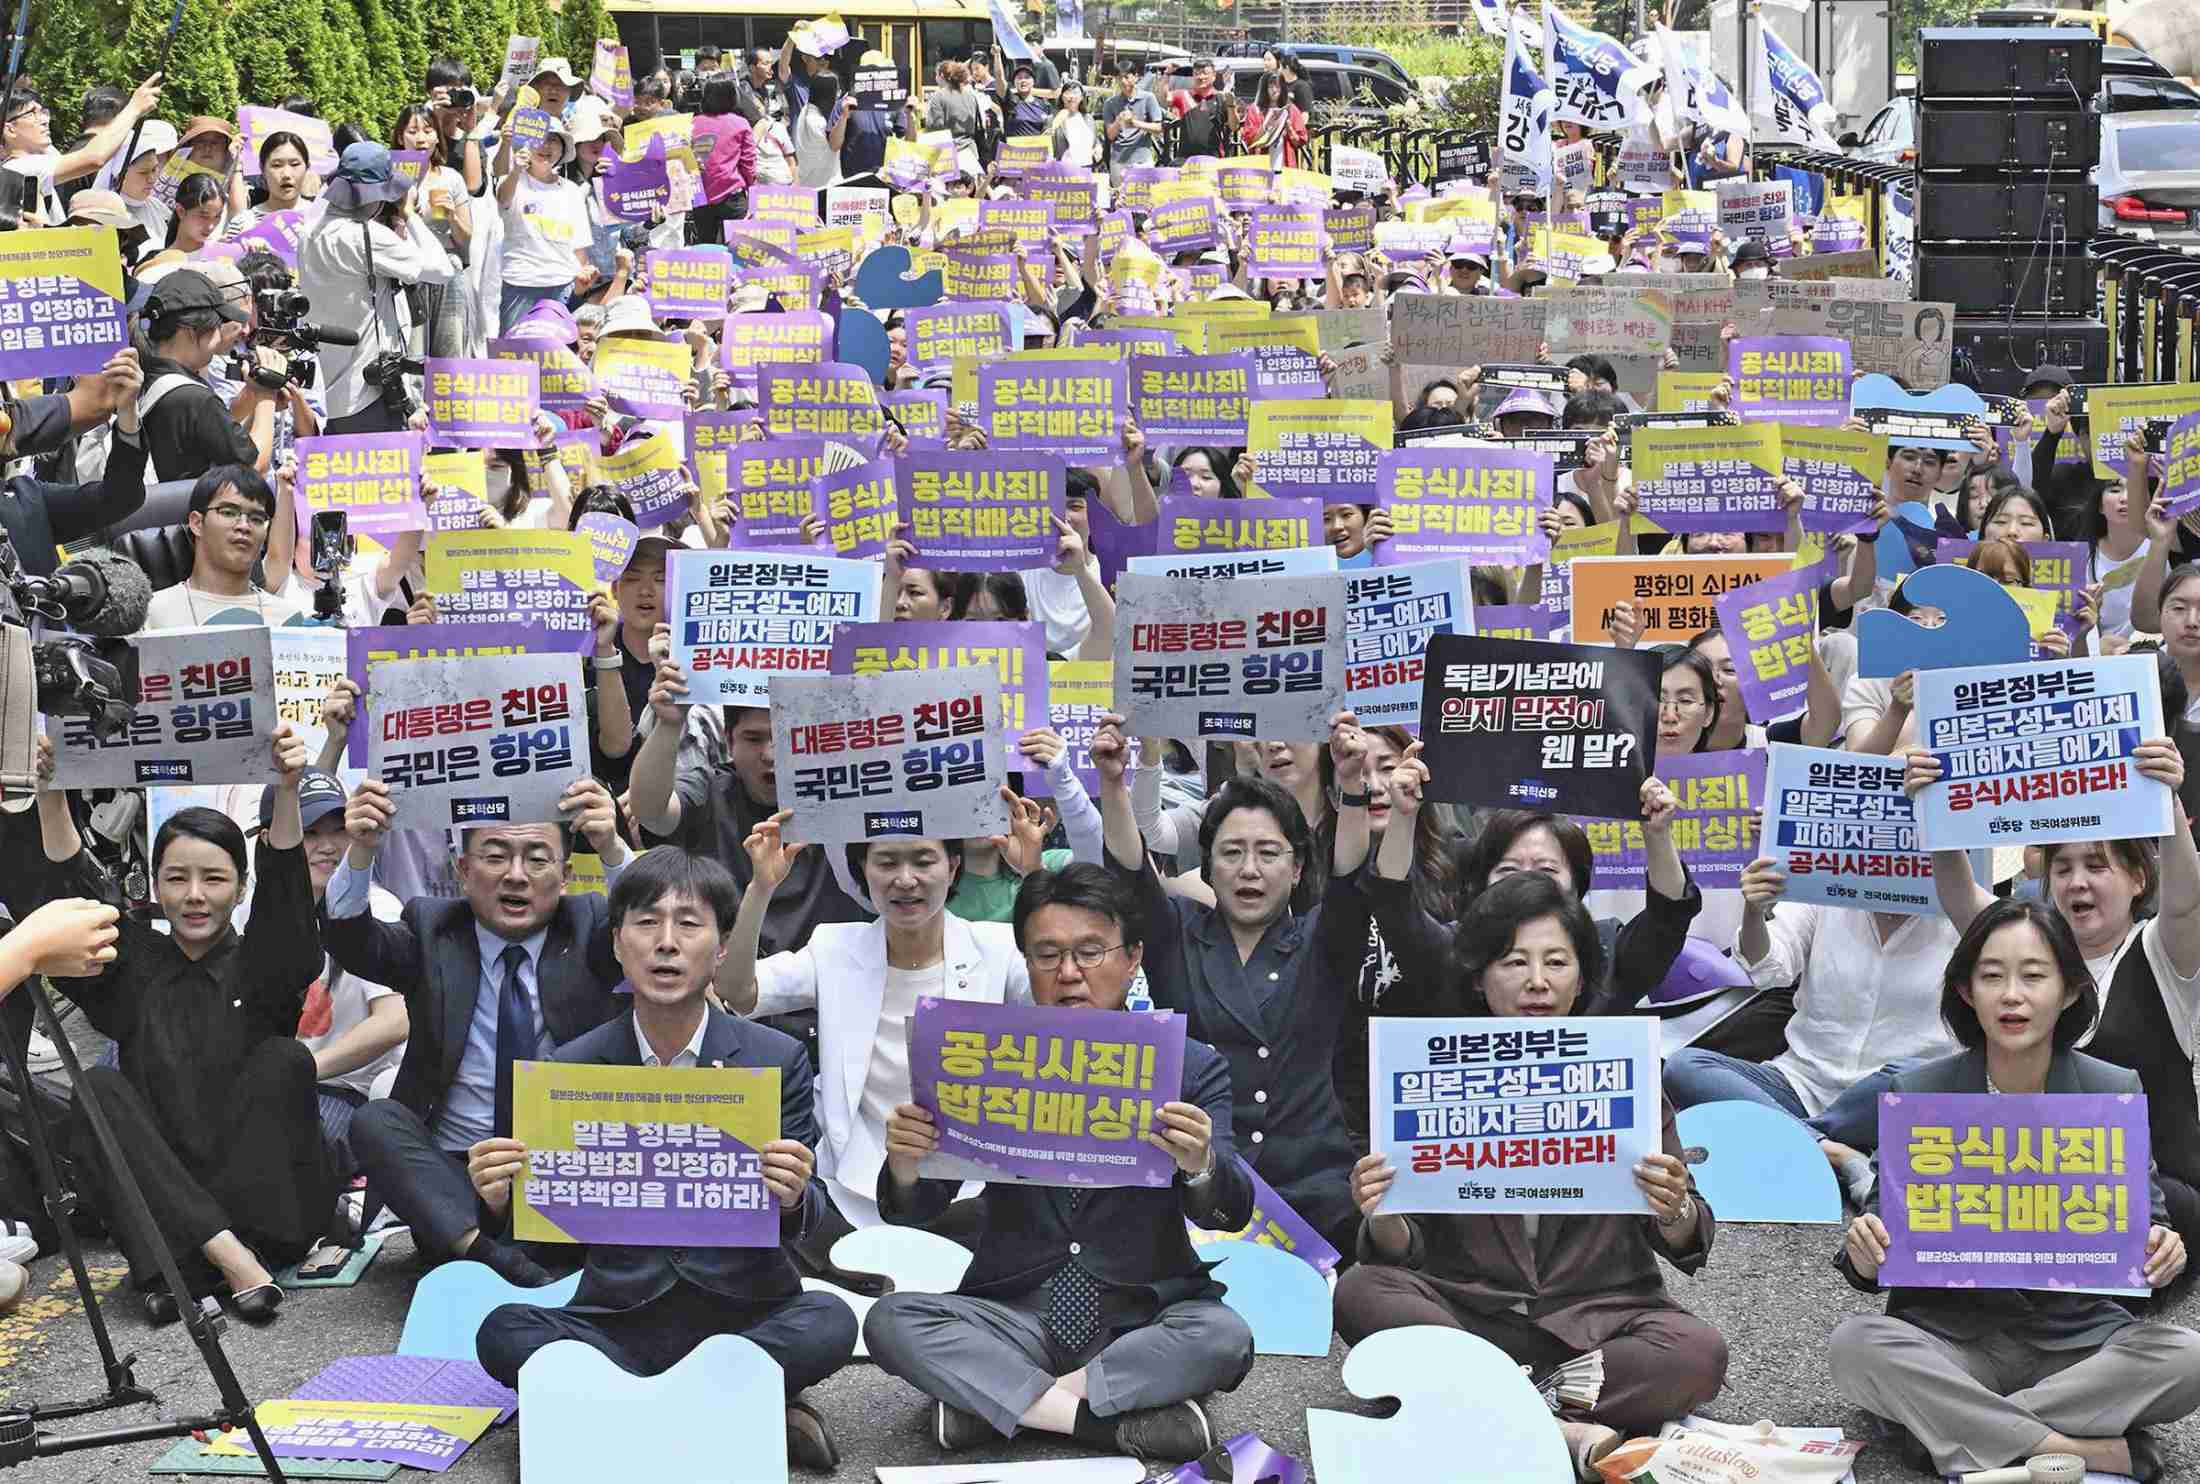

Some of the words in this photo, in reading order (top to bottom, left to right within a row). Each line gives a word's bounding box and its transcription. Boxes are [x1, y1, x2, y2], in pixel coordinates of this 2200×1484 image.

[17, 273, 80, 299] 정부는
[31, 297, 116, 323] 인정하고
[51, 320, 122, 347] 다하라!
[992, 377, 1113, 406] 공식사죄!
[1141, 368, 1247, 395] 공식사죄!
[991, 409, 1114, 439] 법적배상!
[1315, 430, 1362, 450] 정부는
[1393, 467, 1536, 501] 공식사죄!
[1663, 459, 1697, 478] 일본
[1702, 458, 1752, 477] 정부는
[1805, 459, 1852, 477] 정부는
[911, 470, 1049, 501] 공식사죄!
[1636, 477, 1706, 496] 전쟁범죄
[1711, 475, 1778, 493] 인정하고
[1811, 478, 1874, 495] 인정하고
[911, 507, 1054, 539] 법적배상!
[1173, 516, 1311, 551] 공식사죄!
[1391, 503, 1537, 539] 법적배상!
[460, 569, 499, 590] 일본
[503, 568, 560, 589] 정부는
[708, 562, 831, 589] 일본정부는
[1633, 573, 1695, 599] 평화의
[514, 590, 591, 610] 인정하고
[689, 591, 860, 620] 일본군성노예제
[1132, 620, 1248, 655] 대통령은
[1255, 606, 1327, 650] 친일
[179, 656, 255, 703] 친일
[719, 682, 749, 696] 민주당
[1131, 662, 1231, 700] 국민은
[1241, 649, 1324, 695] 항일
[1443, 660, 1605, 693] 독립기념관에
[1954, 667, 2096, 712] 일본정부는
[171, 696, 255, 746] 항일
[383, 697, 492, 744] 대통령은
[500, 682, 570, 728] 친일
[790, 711, 906, 757] 대통령은
[912, 694, 985, 743] 친일
[1441, 696, 1506, 733] 일제
[1511, 695, 1605, 732] 밀정이
[1933, 695, 2134, 748] 일본군성노예제
[382, 745, 480, 790] 국민은
[488, 725, 572, 778] 항일
[1541, 733, 1577, 771] 웬
[1583, 732, 1638, 770] 말?
[1950, 730, 2121, 780] 피해자들에게
[794, 759, 894, 802] 국민은
[902, 738, 986, 796] 항일
[1948, 761, 2129, 813] 공식사죄하라!
[1988, 820, 2024, 835] 민주당
[2029, 814, 2102, 832] 전국여성위원회
[1825, 886, 1858, 901] 민주당
[938, 1029, 1158, 1091] 공식사죄!
[1427, 1027, 1590, 1067] 일본정부는
[1399, 1060, 1628, 1105] 일본군성노예제
[936, 1080, 1153, 1143] 법적배상!
[1415, 1097, 1612, 1140] 피해자들에게
[572, 1119, 628, 1148] 일본
[637, 1120, 723, 1149] 정부는
[1906, 1125, 2128, 1177] 공식사죄!
[527, 1150, 644, 1178] 전쟁범죄
[651, 1150, 765, 1180] 인정하고
[1410, 1134, 1618, 1175] 공식사죄하라!
[522, 1178, 668, 1209] 법적책임을
[676, 1181, 771, 1212] 다하라!
[1457, 1186, 1497, 1201] 민주당
[1503, 1186, 1585, 1201] 전국여성위원회
[1905, 1183, 2131, 1235] 법적배상!
